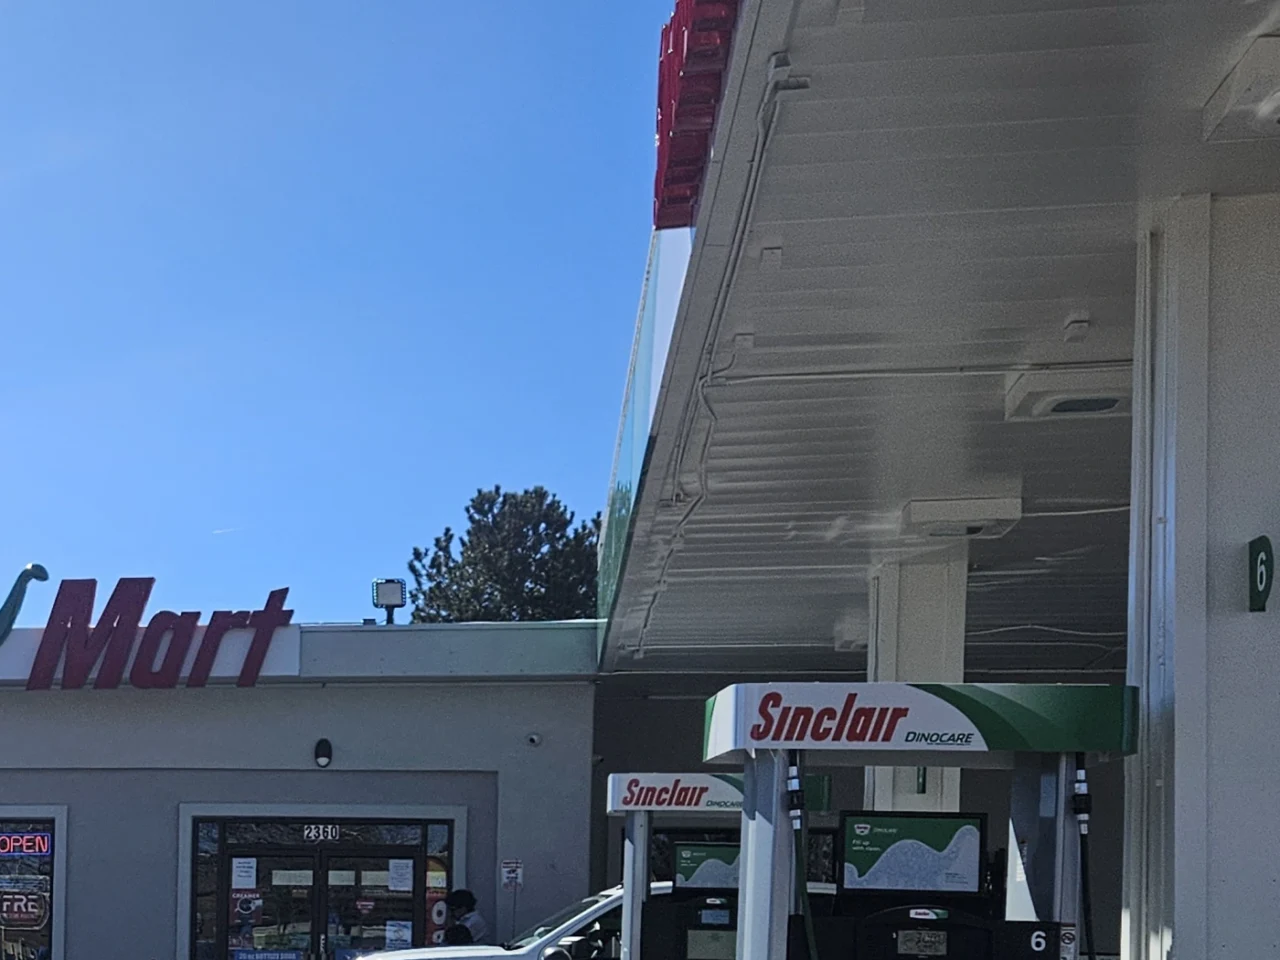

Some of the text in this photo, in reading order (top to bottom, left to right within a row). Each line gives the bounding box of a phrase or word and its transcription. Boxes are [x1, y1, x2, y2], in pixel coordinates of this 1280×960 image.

[1257, 551, 1266, 592] 6
[25, 576, 295, 690] Mart
[750, 691, 909, 743] Sinclair
[904, 731, 975, 743] DINOCARE
[622, 778, 709, 807] Sinclair
[304, 825, 339, 840] 2360
[2, 894, 38, 912] FRE
[1030, 930, 1047, 952] 6
